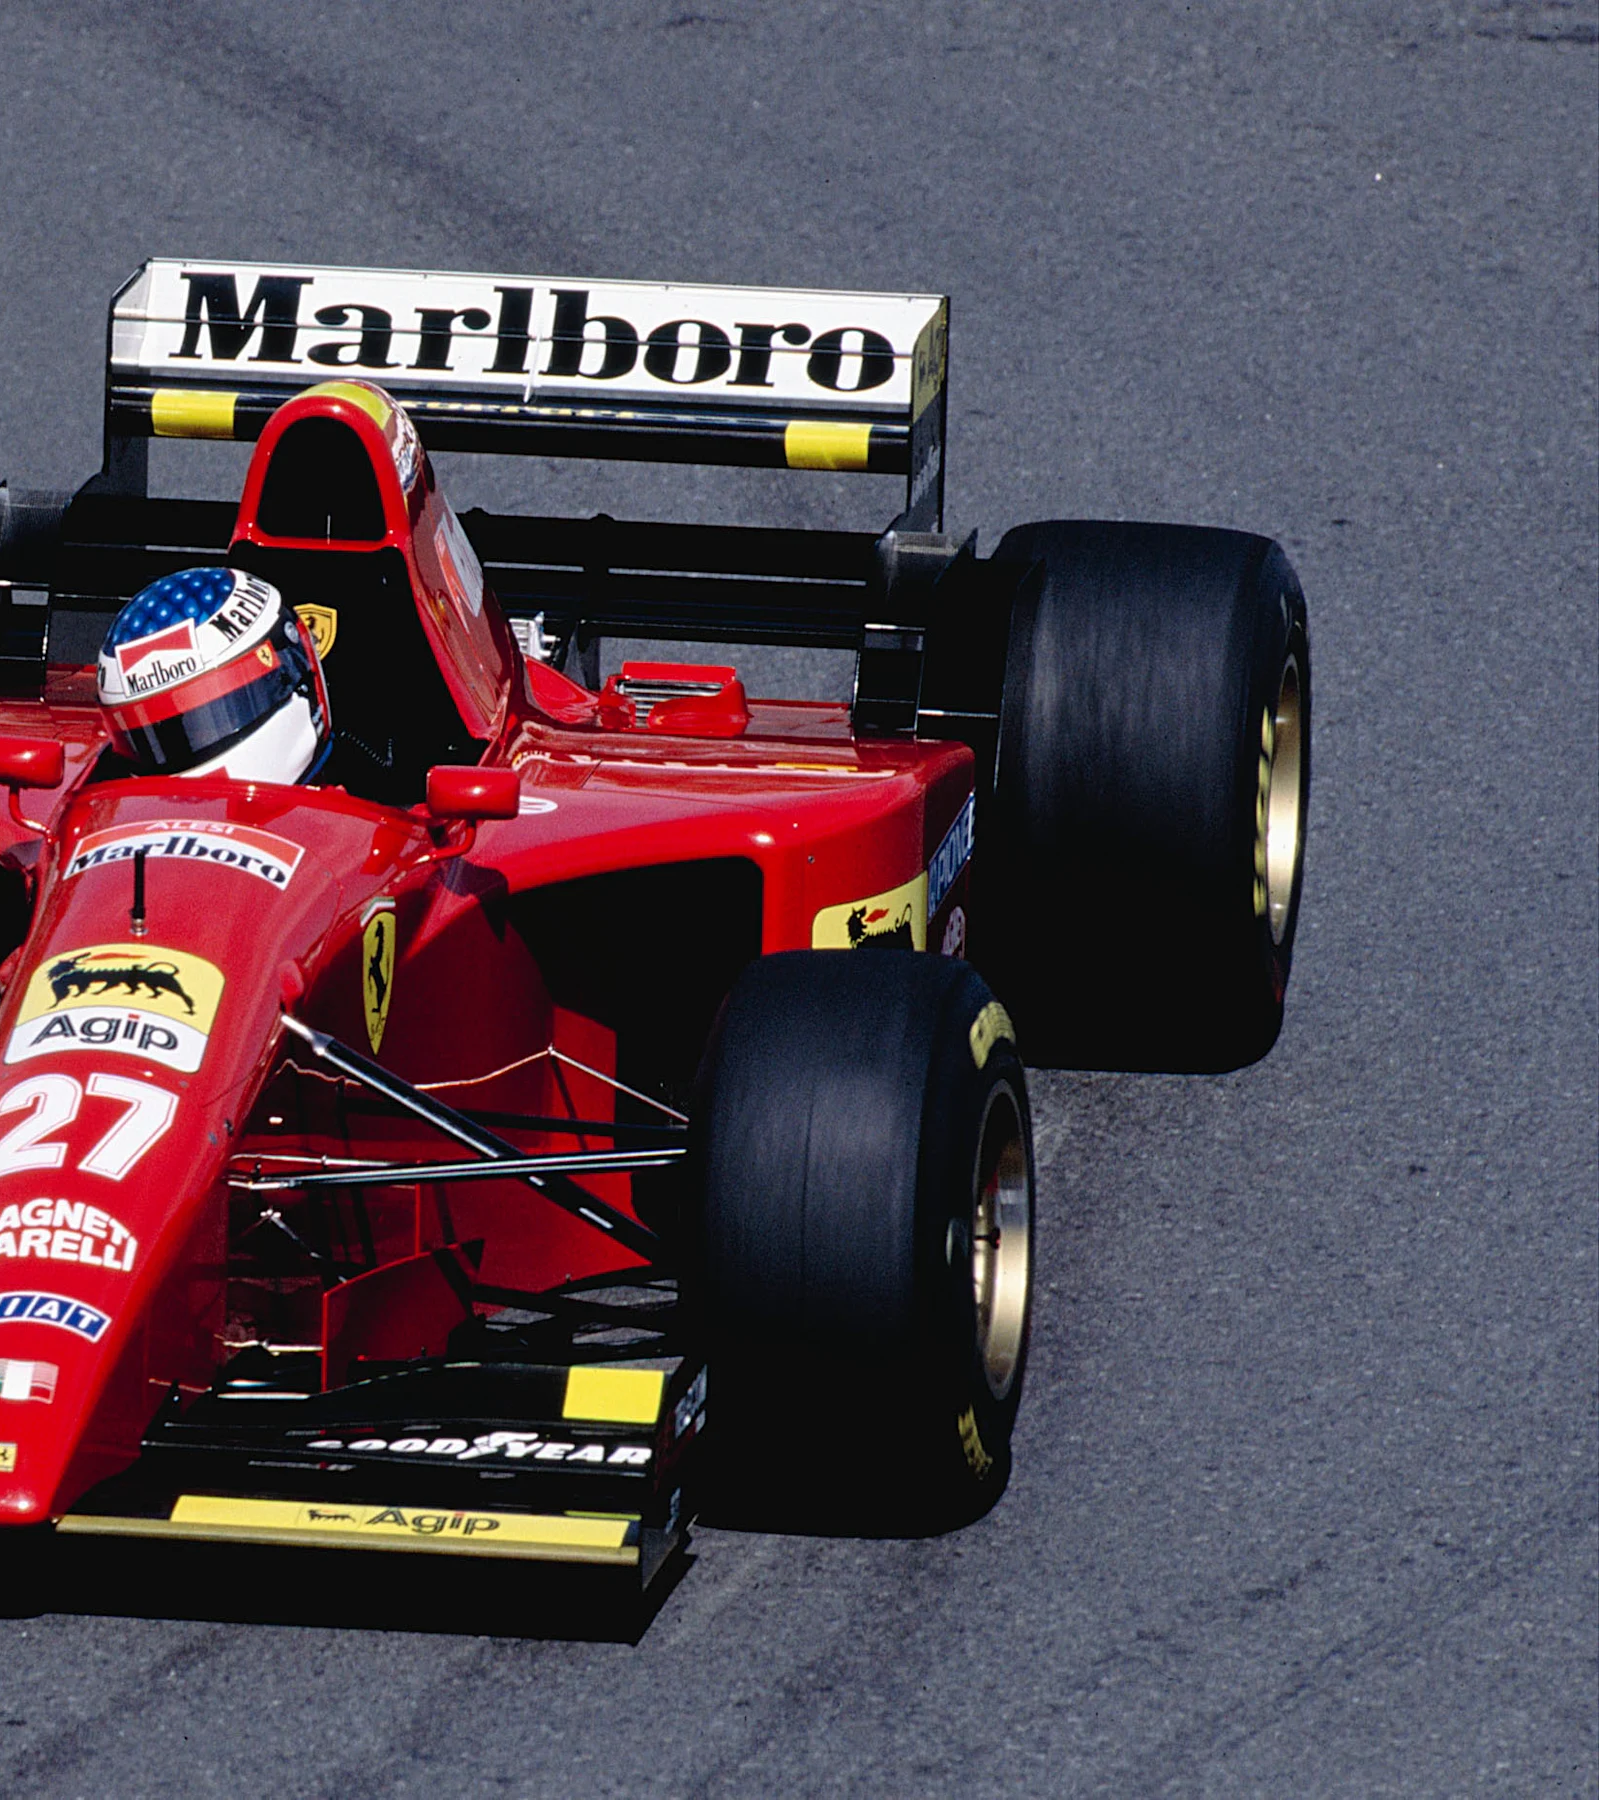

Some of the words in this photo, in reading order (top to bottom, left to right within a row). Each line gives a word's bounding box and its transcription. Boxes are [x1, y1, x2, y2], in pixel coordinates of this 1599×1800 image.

[169, 272, 897, 393] Marlboro
[127, 655, 197, 695] Marlboro
[145, 821, 235, 835] ALESI
[70, 836, 286, 884] Marlboro
[29, 1013, 178, 1051] Agip
[365, 1506, 500, 1535] Agip
